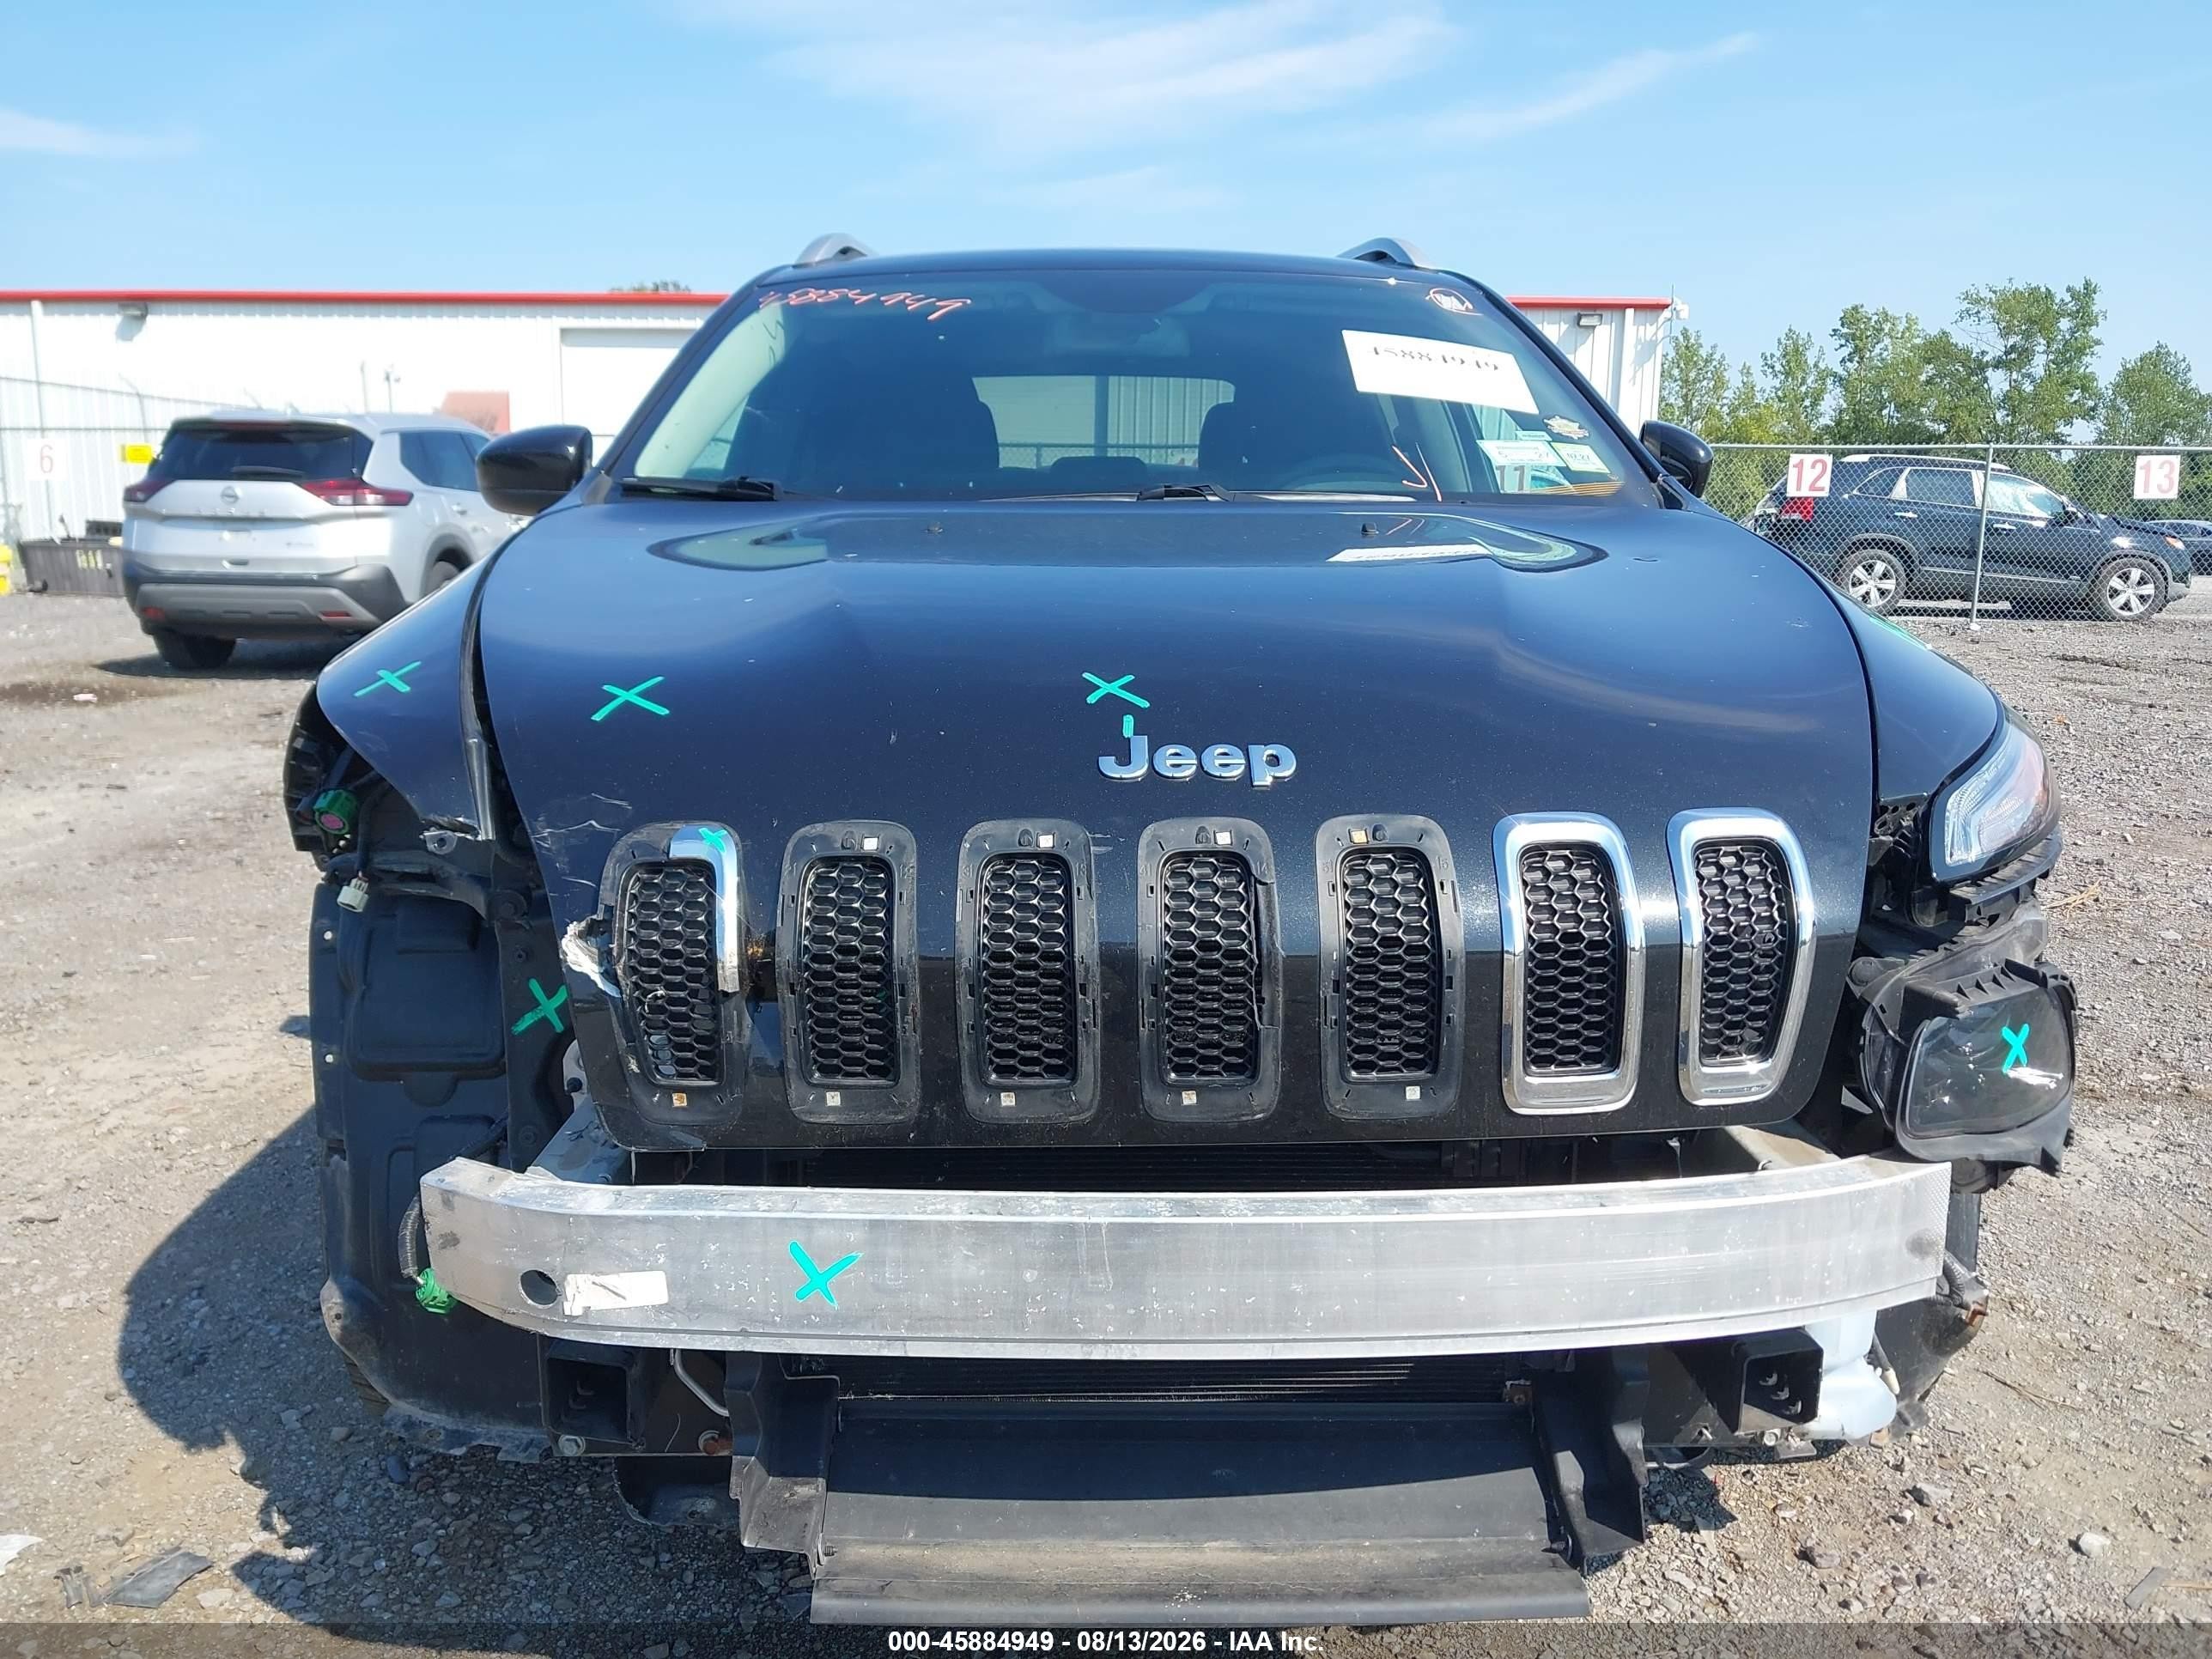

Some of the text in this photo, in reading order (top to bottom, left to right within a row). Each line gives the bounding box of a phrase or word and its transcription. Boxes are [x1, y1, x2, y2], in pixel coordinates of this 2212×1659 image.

[39, 443, 54, 474] 6
[1793, 459, 1827, 491] 12
[2139, 459, 2176, 494] 13
[1097, 735, 1297, 788] Jeep
